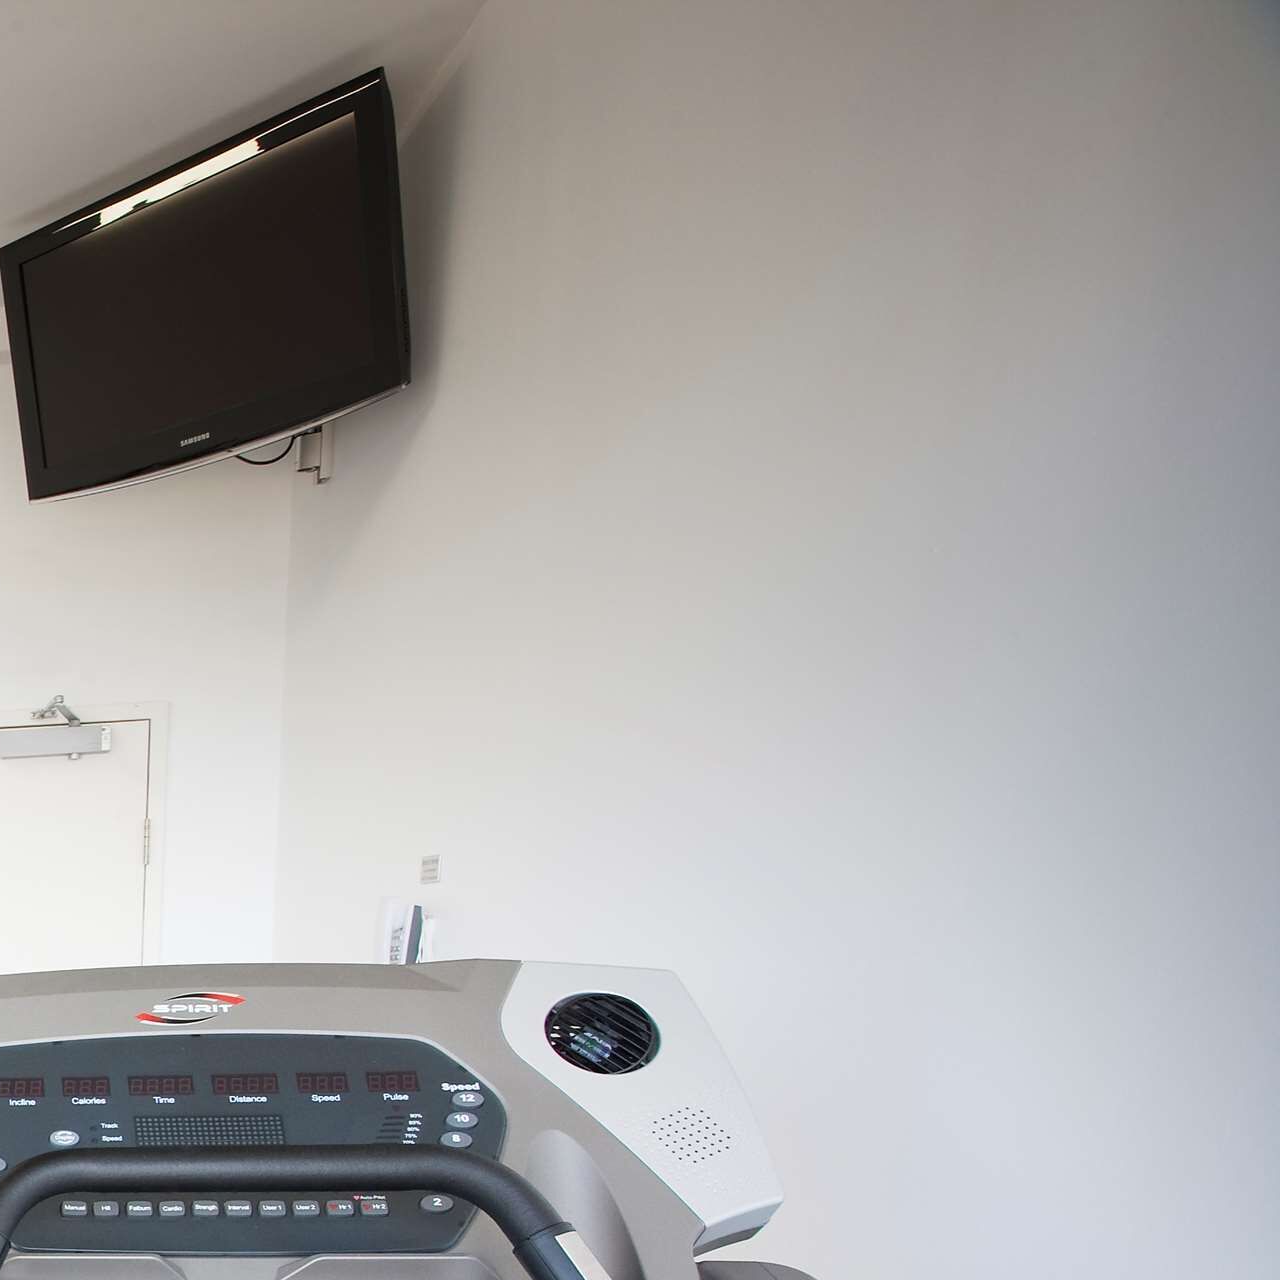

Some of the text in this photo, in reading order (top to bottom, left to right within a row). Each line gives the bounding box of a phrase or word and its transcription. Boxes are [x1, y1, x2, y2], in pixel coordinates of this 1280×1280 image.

[180, 432, 210, 447] SAMSUNG
[151, 1003, 233, 1014] SPIRIT
[441, 1082, 480, 1092] Speed
[71, 1097, 107, 1105] Calories
[152, 1096, 176, 1104] Time
[228, 1095, 268, 1103] Distance
[311, 1094, 341, 1102] Speed
[383, 1093, 409, 1101] Pulse
[459, 1094, 475, 1102] 12
[9, 1098, 37, 1106] Incline
[454, 1114, 469, 1123] 10
[452, 1134, 461, 1143] 8
[432, 1197, 442, 1207] 2
